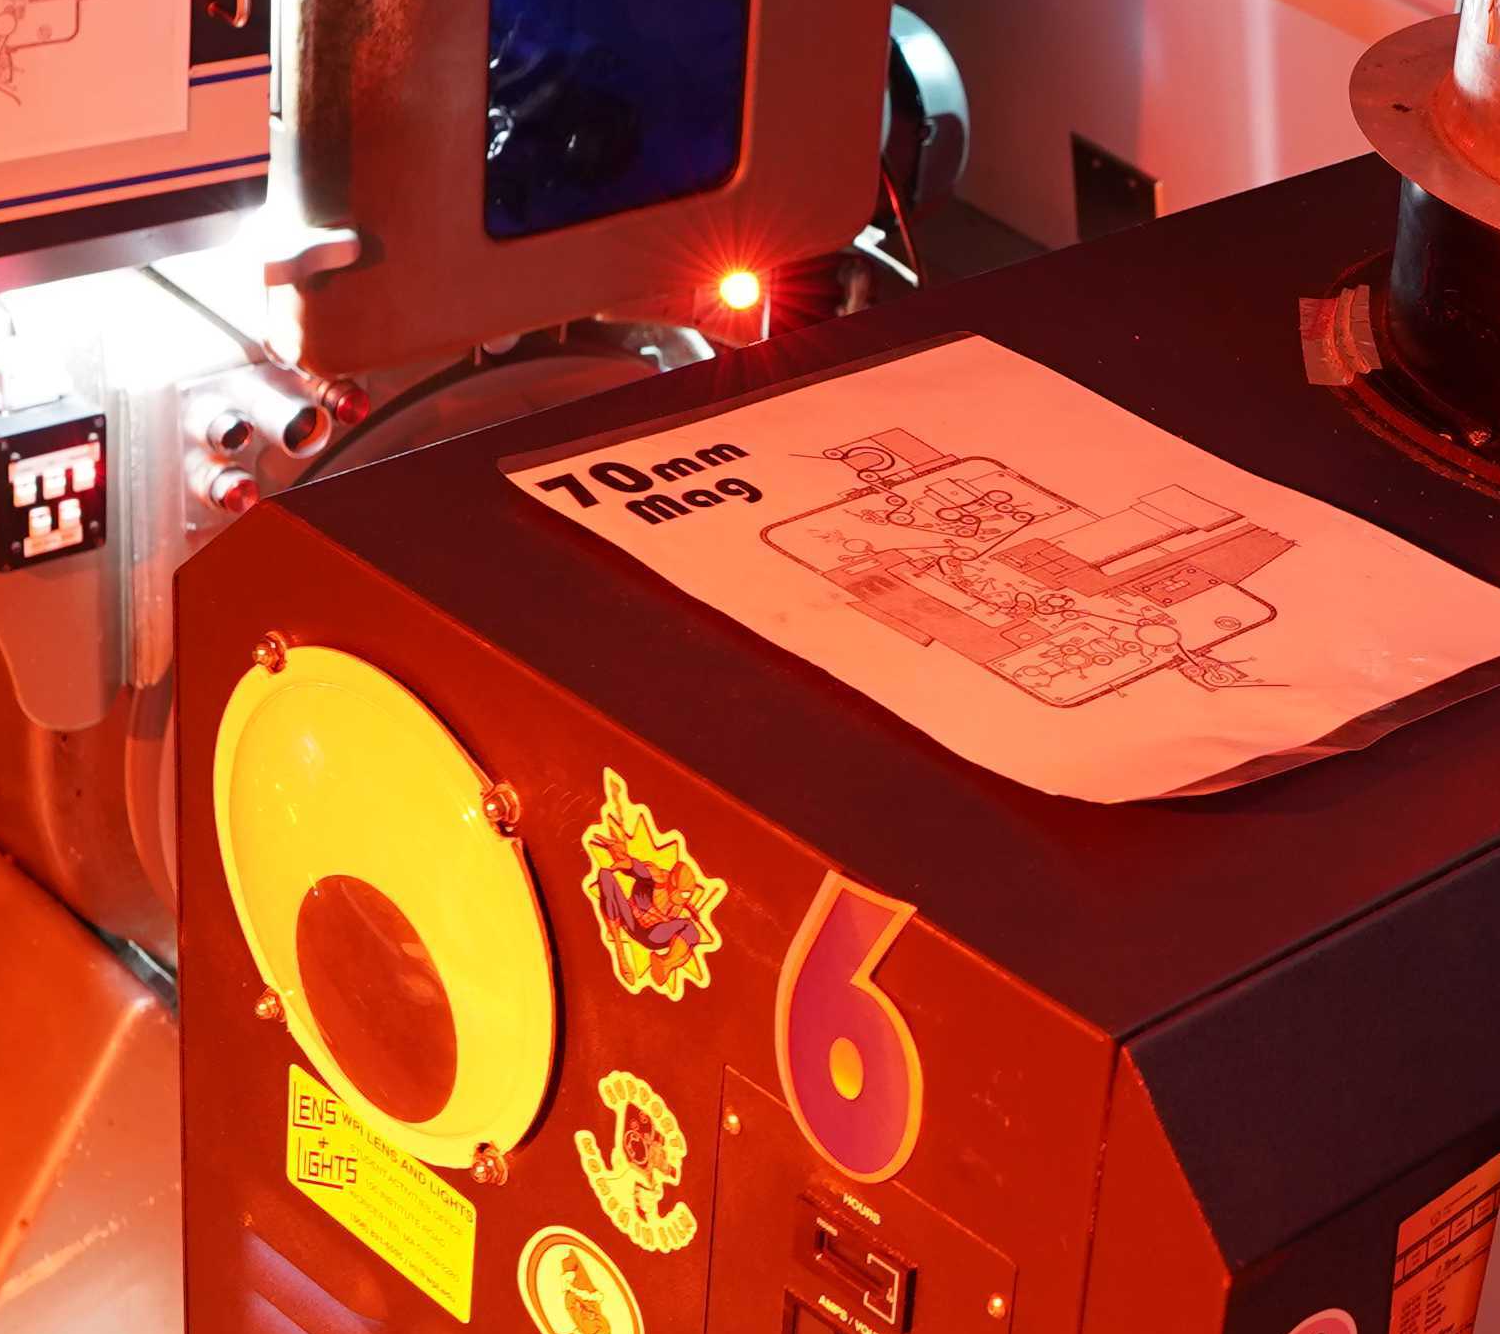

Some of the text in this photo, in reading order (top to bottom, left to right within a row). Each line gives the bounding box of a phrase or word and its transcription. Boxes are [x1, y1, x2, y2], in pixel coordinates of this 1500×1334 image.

[534, 443, 751, 509] 70mm
[624, 477, 764, 526] Mag
[775, 868, 924, 1185] 6
[293, 1080, 338, 1131] LENS
[297, 1136, 358, 1191] LIGHTS
[340, 1109, 475, 1224] WPI LENS AND LIGHTS
[842, 1192, 882, 1226] HOURS
[817, 1294, 849, 1323] AMPS
